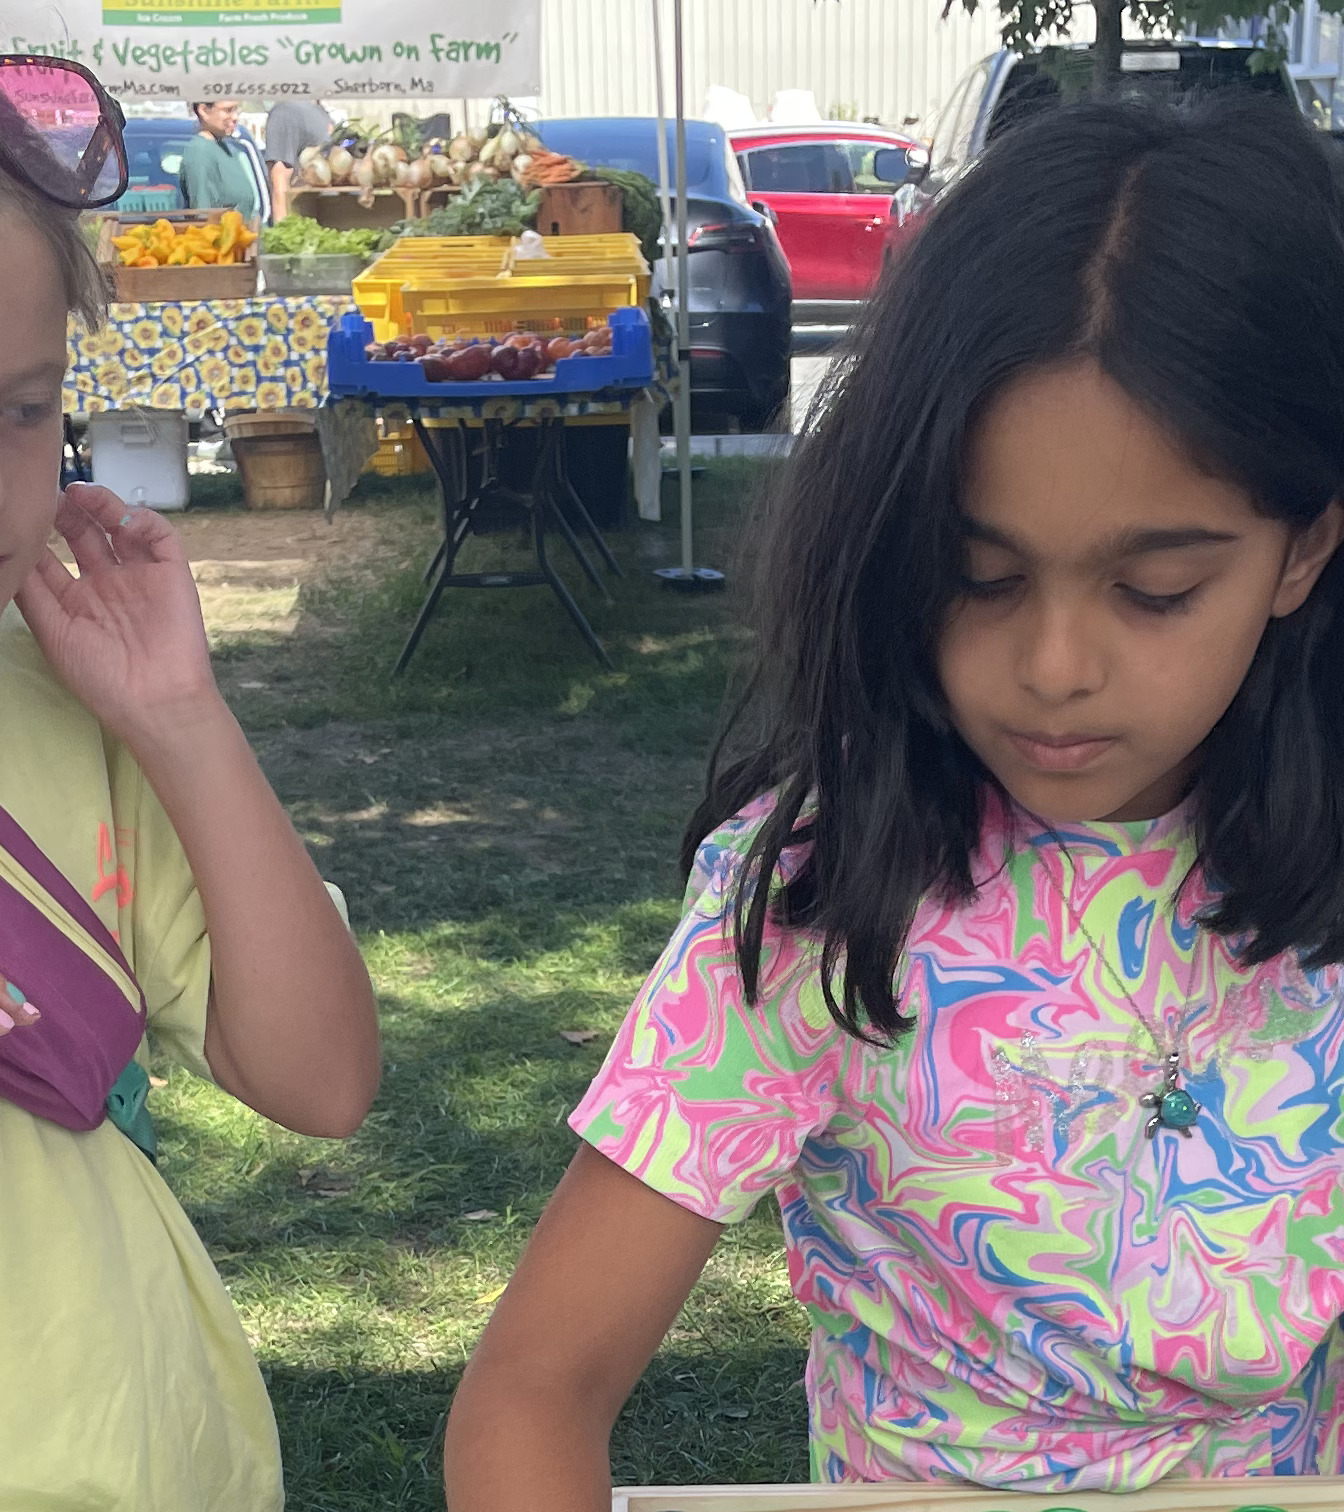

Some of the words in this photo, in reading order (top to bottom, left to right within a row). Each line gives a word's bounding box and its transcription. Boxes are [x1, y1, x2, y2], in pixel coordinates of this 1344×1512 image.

[111, 37, 270, 74] Vegetables
[276, 35, 383, 66] "Grown
[393, 40, 421, 63] on
